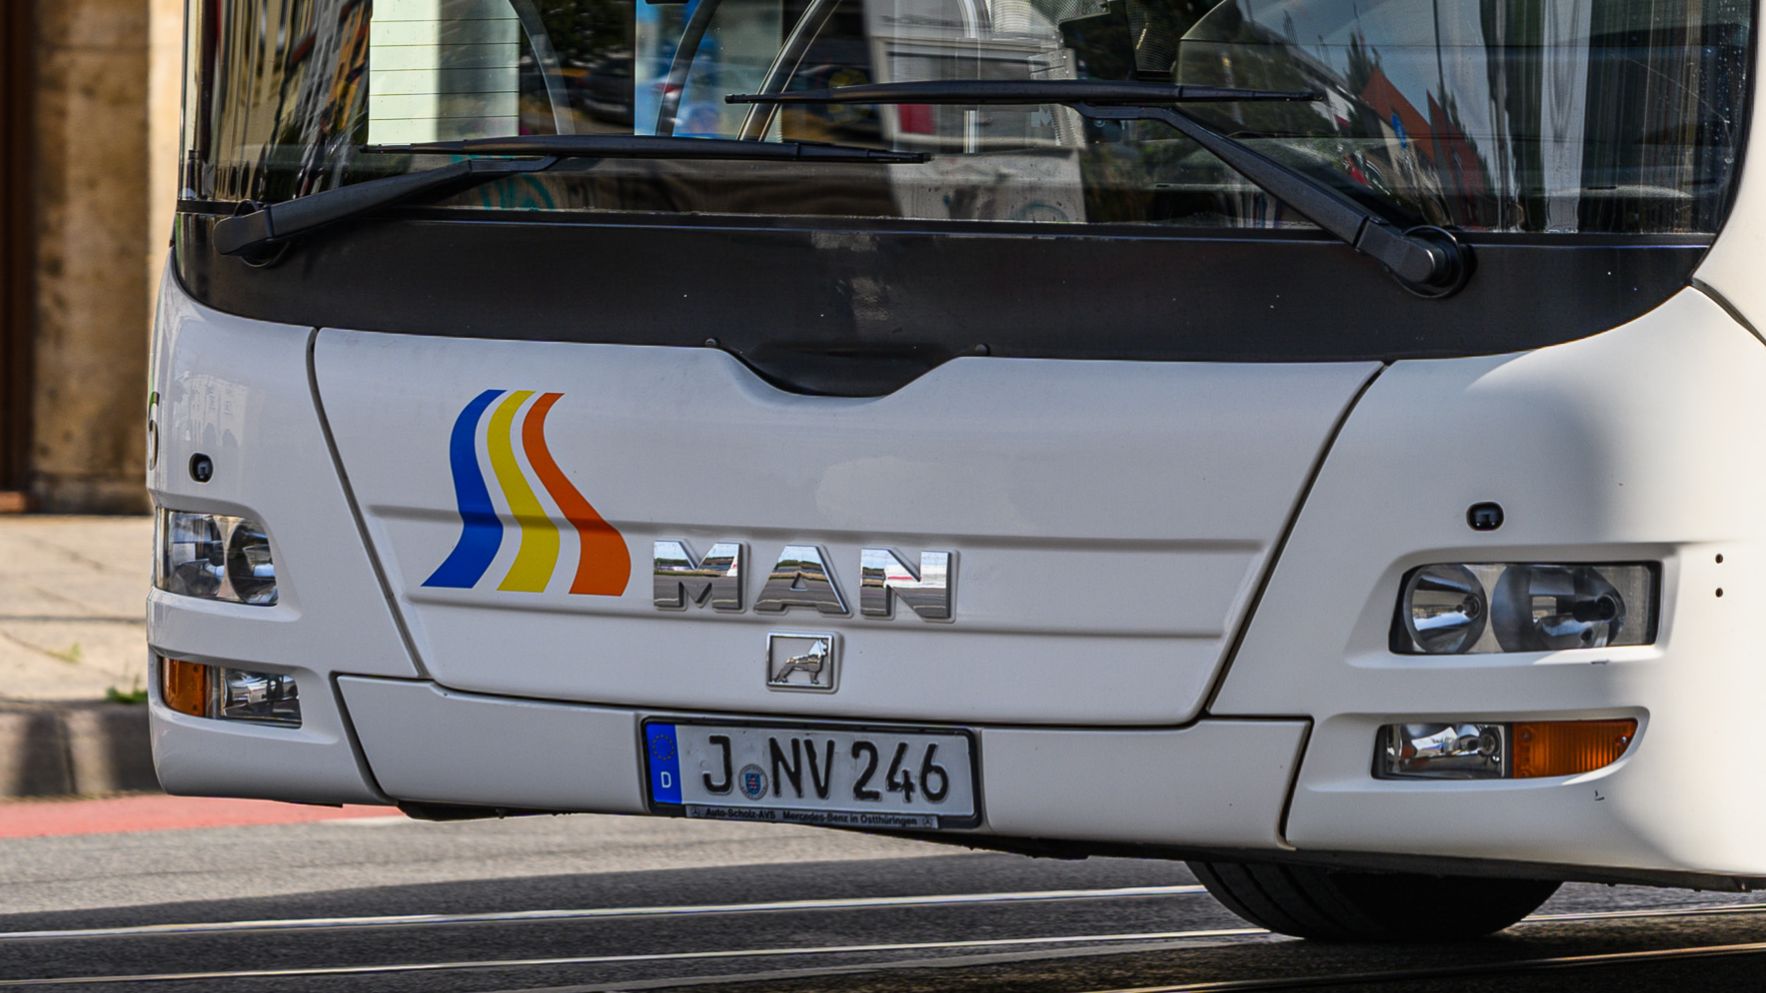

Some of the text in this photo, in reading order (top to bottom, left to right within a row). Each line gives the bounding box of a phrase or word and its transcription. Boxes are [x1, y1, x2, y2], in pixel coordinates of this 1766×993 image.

[653, 540, 952, 619] MAN
[661, 772, 672, 788] D
[702, 735, 733, 793] J
[769, 737, 836, 799] NV
[851, 741, 949, 803] 246
[783, 810, 848, 824] Mercedes-Benz
[860, 814, 918, 827] Ostthüringen
